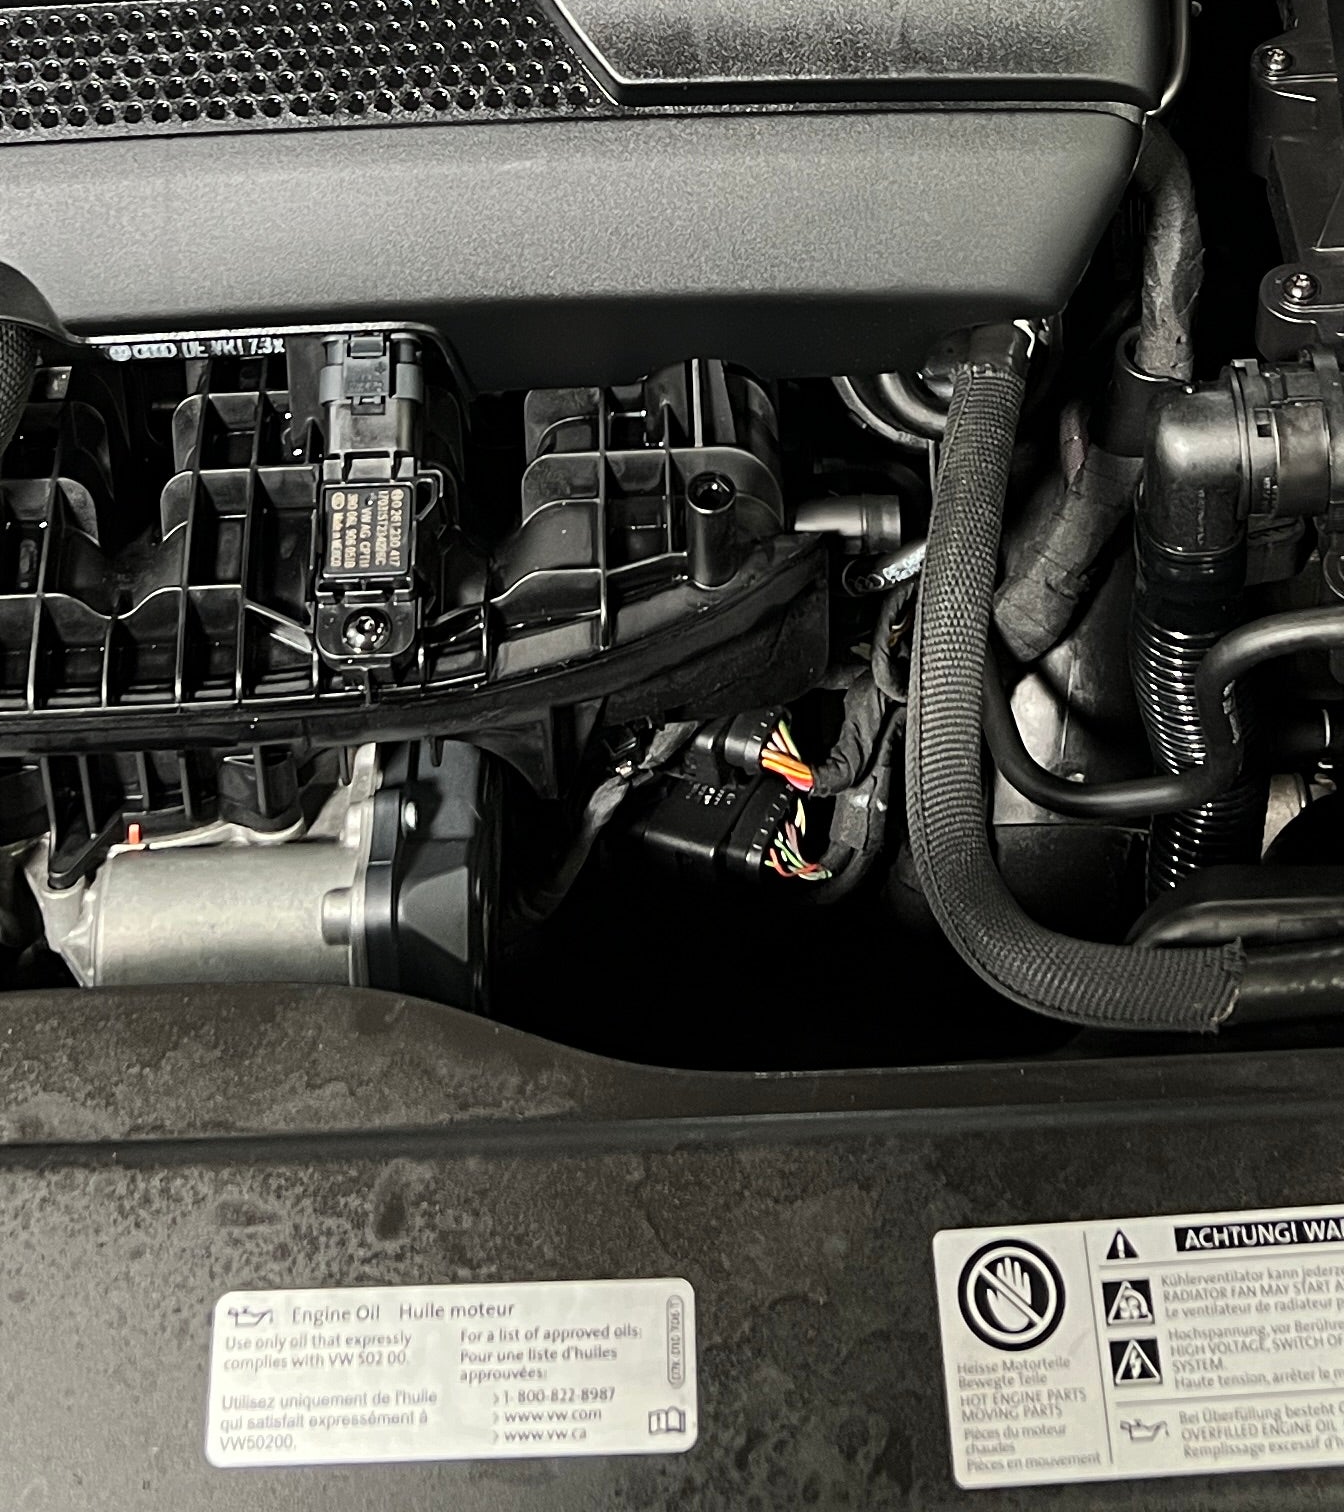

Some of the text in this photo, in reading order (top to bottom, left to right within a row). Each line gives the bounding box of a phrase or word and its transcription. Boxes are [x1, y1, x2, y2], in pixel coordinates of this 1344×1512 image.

[1185, 1221, 1298, 1249] ACHTUNG!
[1267, 1267, 1299, 1280] kann
[1163, 1287, 1227, 1303] RADIATOR
[1231, 1283, 1257, 1298] FAN
[1260, 1282, 1291, 1296] MAY
[1294, 1280, 1330, 1295] START
[292, 1302, 514, 1327] Engine Oil Huile moteur
[1182, 1302, 1252, 1317] ventilateur
[1255, 1300, 1271, 1313] de
[1274, 1296, 1332, 1312] radiateur
[225, 1330, 412, 1353] Use only oil that expressly
[460, 1327, 485, 1344] For
[487, 1328, 495, 1342] a
[499, 1326, 520, 1342] list
[525, 1325, 540, 1341] of
[544, 1324, 610, 1345] approved
[460, 1349, 493, 1364] Pour
[497, 1351, 524, 1362] une
[528, 1347, 558, 1361] liste
[1171, 1342, 1206, 1357] HIGH
[1272, 1335, 1324, 1352] SWITCH
[224, 1356, 287, 1375] complies
[291, 1353, 325, 1369] with
[328, 1352, 354, 1366] VW
[359, 1351, 383, 1366] 502
[1002, 1358, 1071, 1372] Motorteile
[222, 1395, 275, 1411] Utilisez
[280, 1392, 368, 1412] uniquement
[372, 1390, 390, 1404] de
[960, 1387, 1087, 1407] HOT ENGINE PARTS
[220, 1416, 243, 1433] qui
[247, 1412, 304, 1430] satisfait
[962, 1405, 1063, 1422] MOVING PARTS
[1003, 1426, 1019, 1439] du
[1022, 1424, 1066, 1438] moteur
[1182, 1423, 1259, 1441] OVERFILLED
[1262, 1420, 1311, 1436] ENGINE
[1315, 1418, 1336, 1433] OIL
[1025, 1452, 1101, 1469] mouvement
